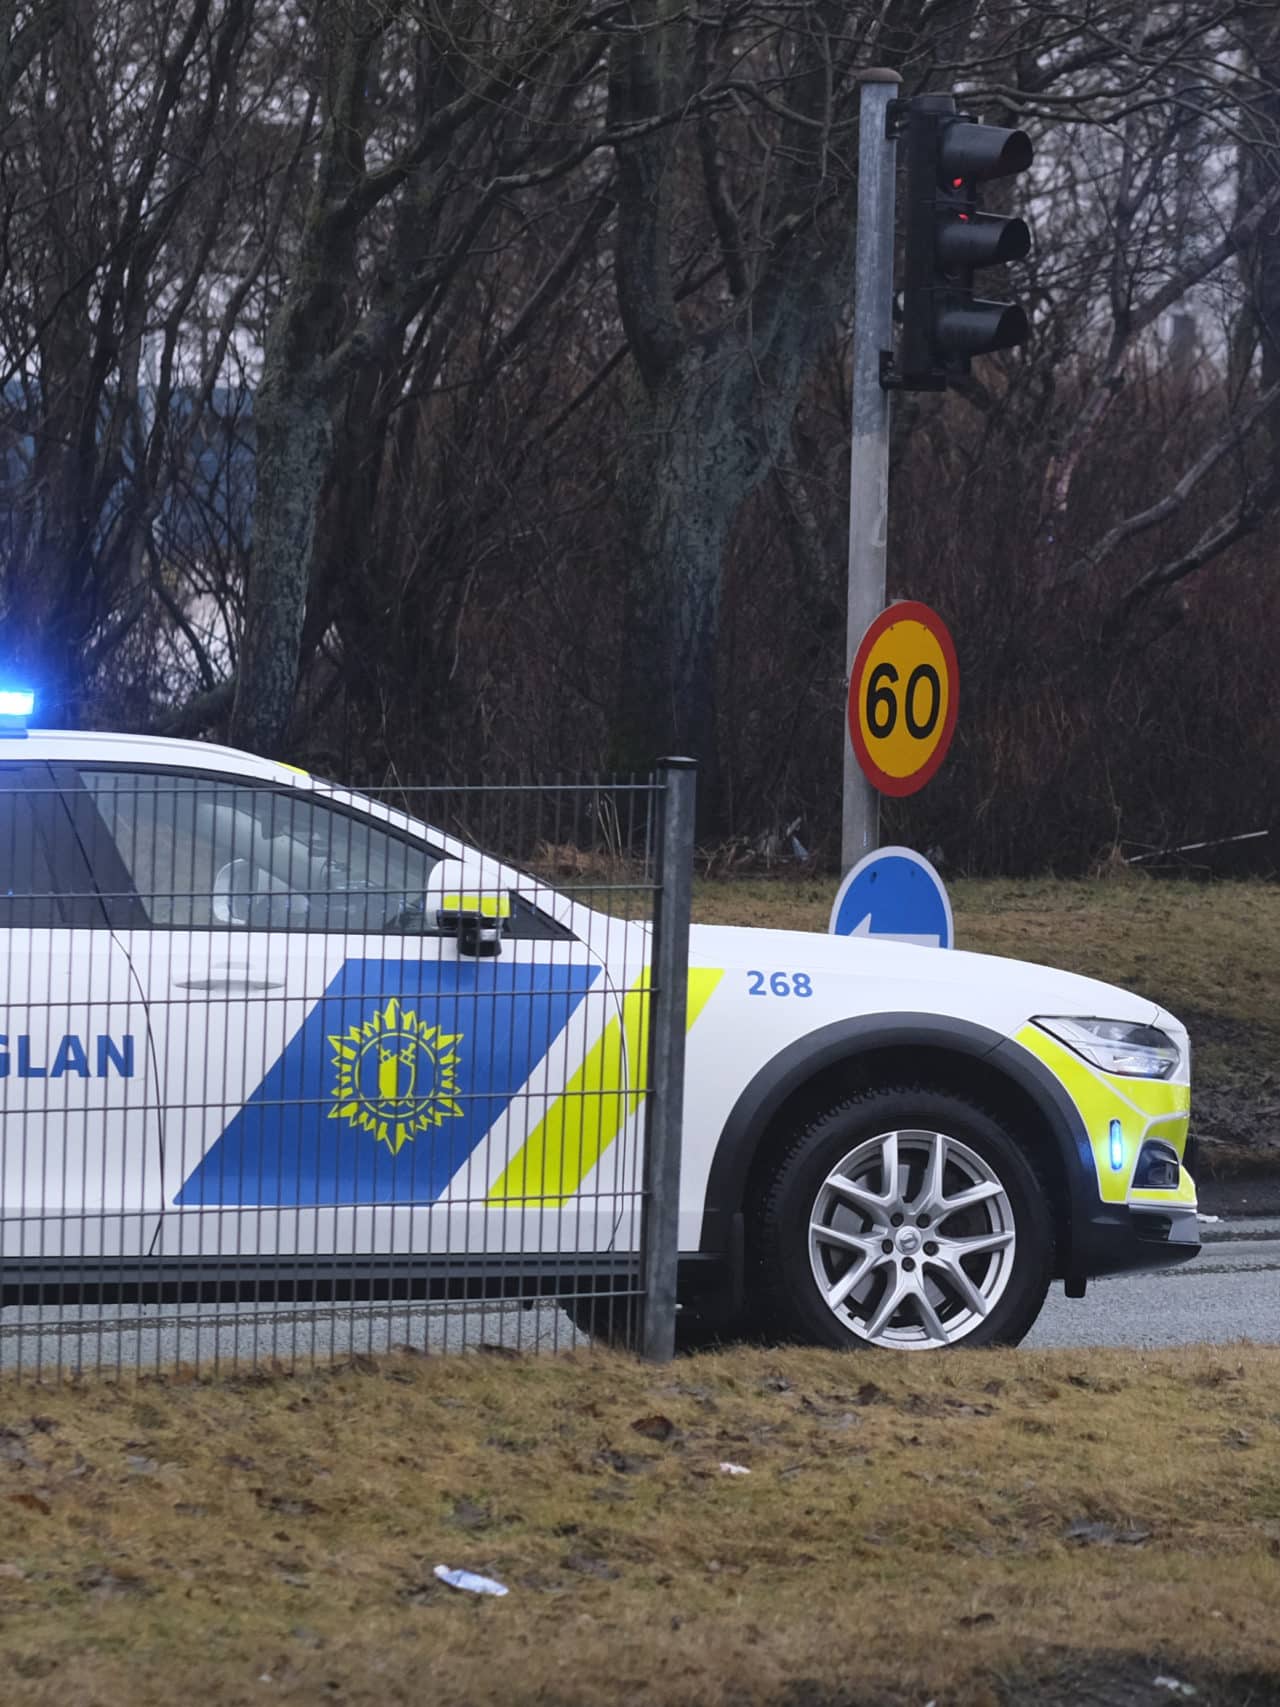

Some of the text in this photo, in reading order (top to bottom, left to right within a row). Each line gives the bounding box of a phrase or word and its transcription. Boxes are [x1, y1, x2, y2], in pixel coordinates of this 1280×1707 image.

[866, 662, 941, 740] 60
[747, 970, 813, 998] 268
[0, 1034, 134, 1078] LAN
